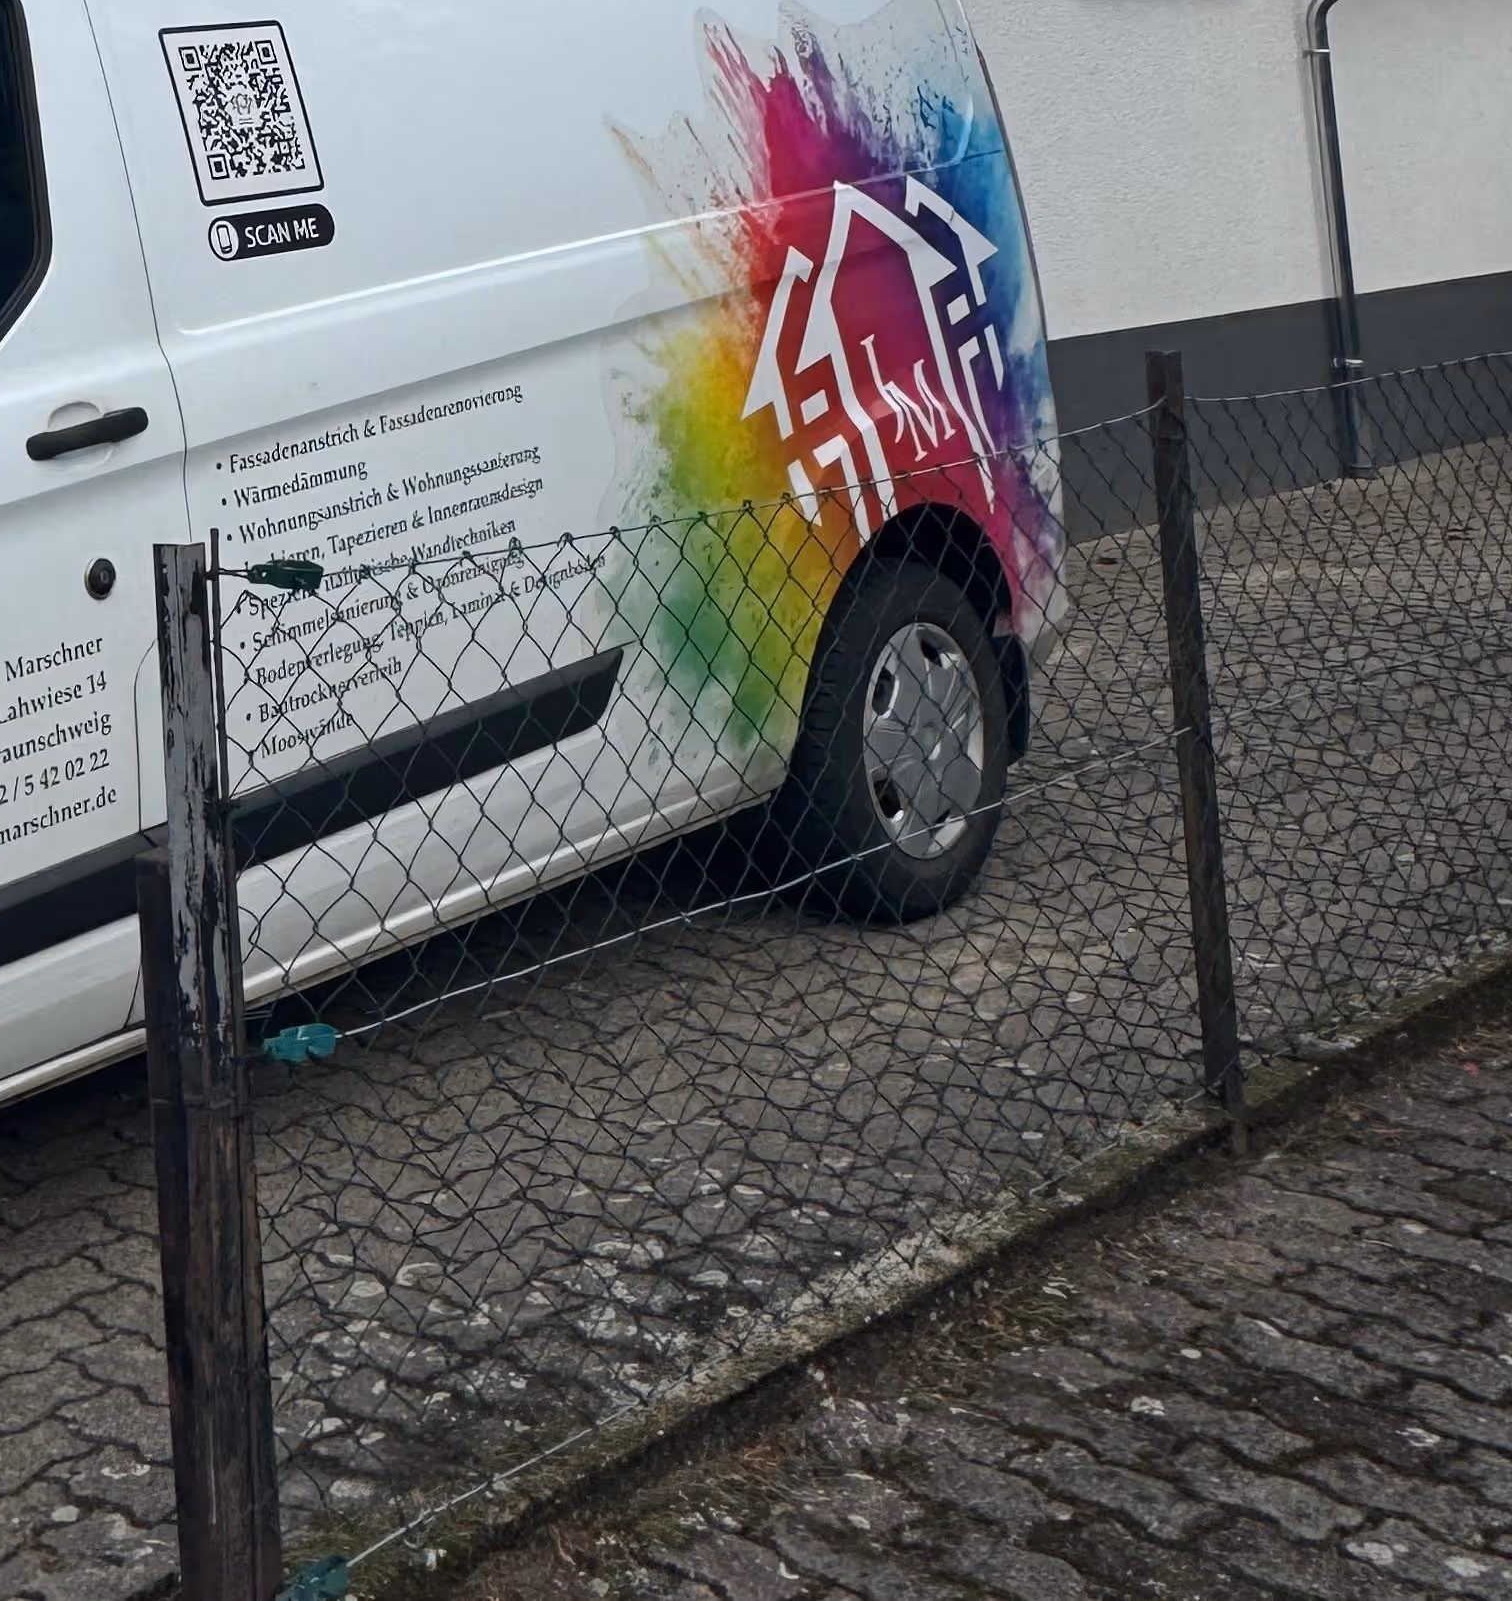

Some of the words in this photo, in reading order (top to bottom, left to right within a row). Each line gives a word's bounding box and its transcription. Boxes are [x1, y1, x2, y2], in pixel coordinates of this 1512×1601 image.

[245, 222, 292, 248] SCAN
[294, 218, 320, 240] ME
[230, 423, 359, 473] Fassadenanstrich
[364, 419, 377, 438] &
[380, 385, 523, 433] Fassadenrenovierung
[234, 461, 368, 508] Wärmedämmung
[239, 487, 382, 544] Wohnungsanstrich
[387, 483, 400, 502] &
[402, 447, 541, 497] Wohnungssanierung
[327, 519, 407, 556] Tapezieren
[412, 510, 425, 529] &
[428, 478, 543, 524] Innenraumdesign
[410, 518, 516, 566] Wandtechniken
[253, 590, 402, 651] Schimmelsanierung
[407, 582, 419, 599] &
[4, 636, 104, 682] Marschner
[87, 670, 107, 695] 14
[259, 656, 402, 723] Bautrocknerverleih
[12, 777, 20, 802] /
[24, 773, 34, 796] 5
[39, 764, 61, 790] 42
[65, 759, 85, 782] 02
[89, 748, 110, 774] 22
